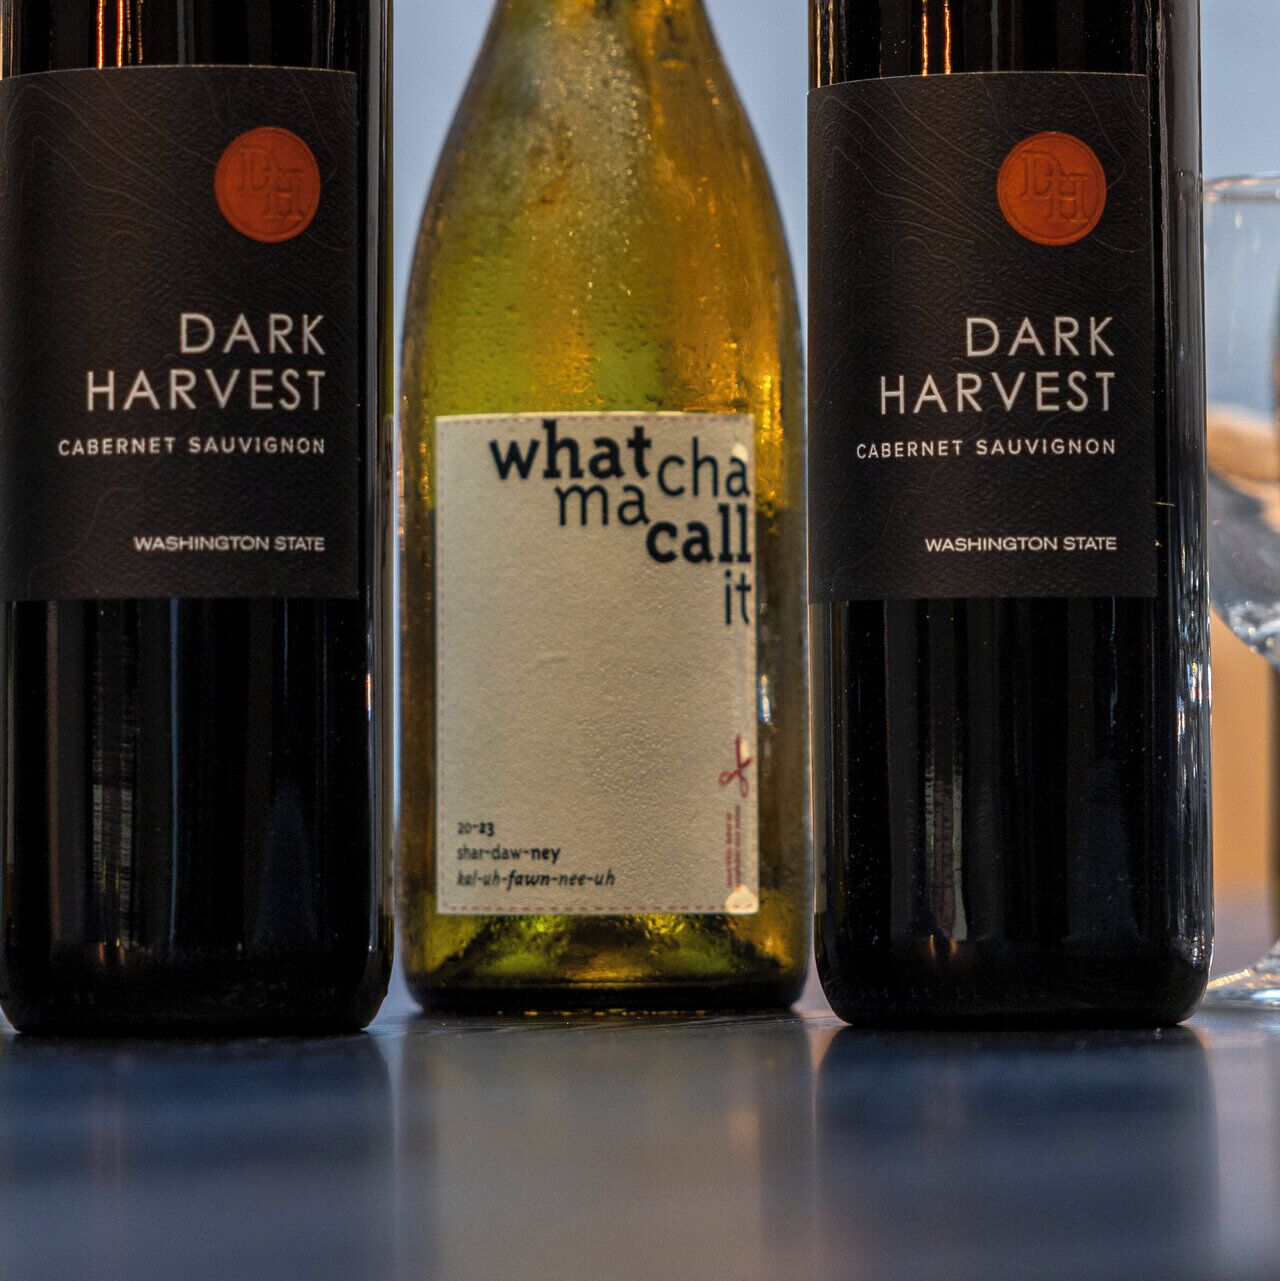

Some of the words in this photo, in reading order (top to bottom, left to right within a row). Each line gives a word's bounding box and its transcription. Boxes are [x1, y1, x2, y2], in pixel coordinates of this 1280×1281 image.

[180, 313, 324, 354] DARK
[966, 317, 1113, 357] DARK
[87, 369, 324, 411] HARVEST
[881, 371, 1114, 414] HARVEST
[59, 437, 175, 455] CABERNET
[189, 436, 324, 454] SAUVIGNON
[490, 420, 651, 480] what
[657, 437, 750, 497] cha
[857, 440, 962, 458] CABERNET
[976, 438, 1114, 455] SAUVIGNON
[555, 484, 651, 527] ma
[134, 536, 269, 551] WASHINGTON
[275, 536, 324, 551] STATE
[646, 503, 752, 564] call
[925, 537, 1057, 552] WASHINGTON
[1063, 536, 1116, 551] STATE
[725, 570, 751, 625] it
[459, 822, 494, 837] 20-23
[458, 846, 560, 864] shar-daw-ney
[458, 869, 615, 890] kal-uh-fawn-nee-uh
